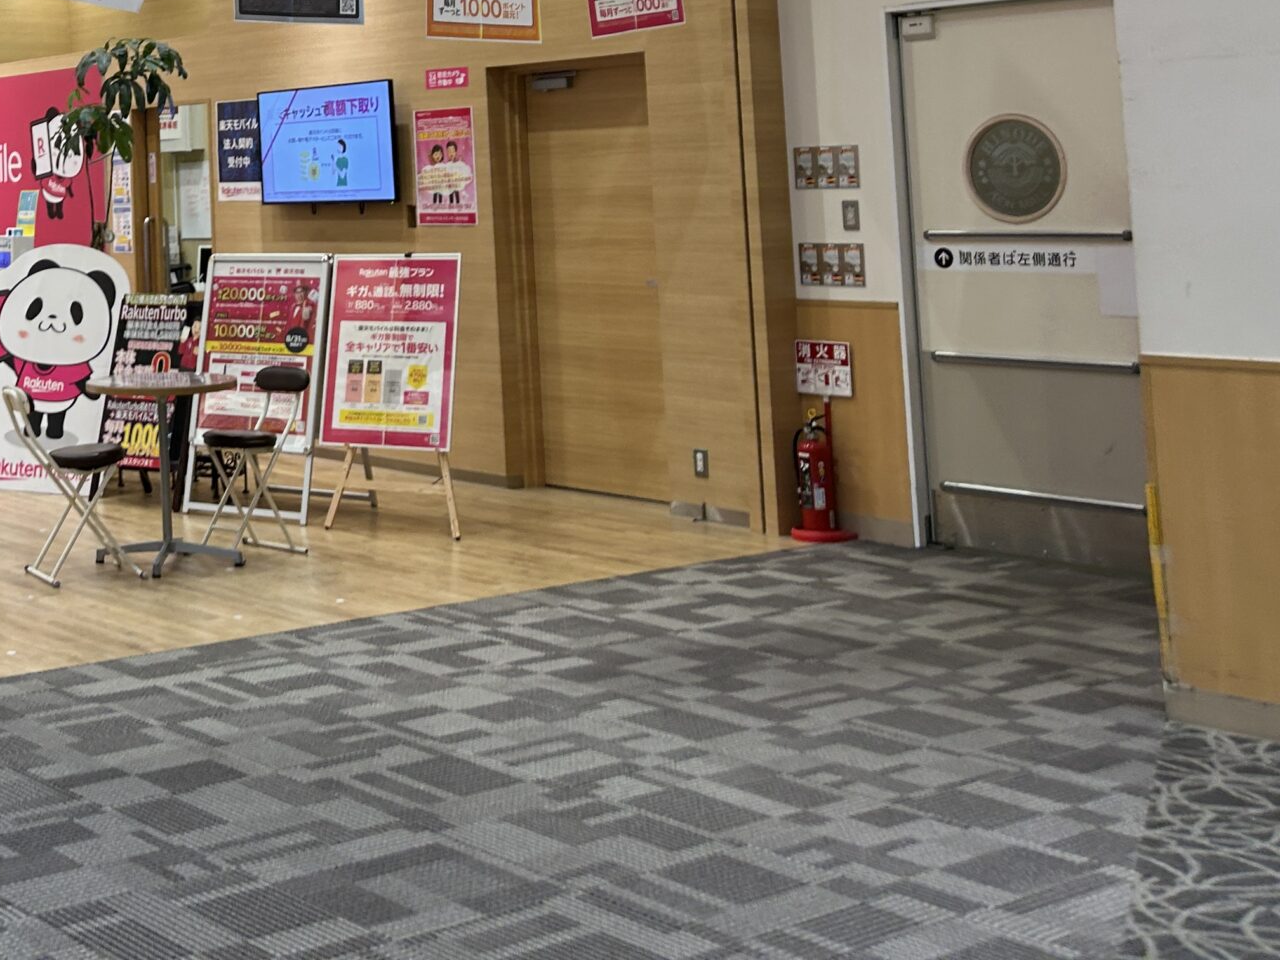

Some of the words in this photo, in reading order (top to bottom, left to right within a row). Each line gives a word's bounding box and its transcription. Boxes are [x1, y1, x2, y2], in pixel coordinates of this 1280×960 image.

[280, 96, 379, 119] キャッシュで高額下取り
[219, 118, 258, 132] 楽天モバイル
[223, 138, 253, 150] 法人契約
[227, 156, 251, 168] 受付中
[345, 342, 438, 354] 全キャリアで1番安い
[799, 344, 847, 360] 消火器
[23, 376, 64, 392] Rakuten
